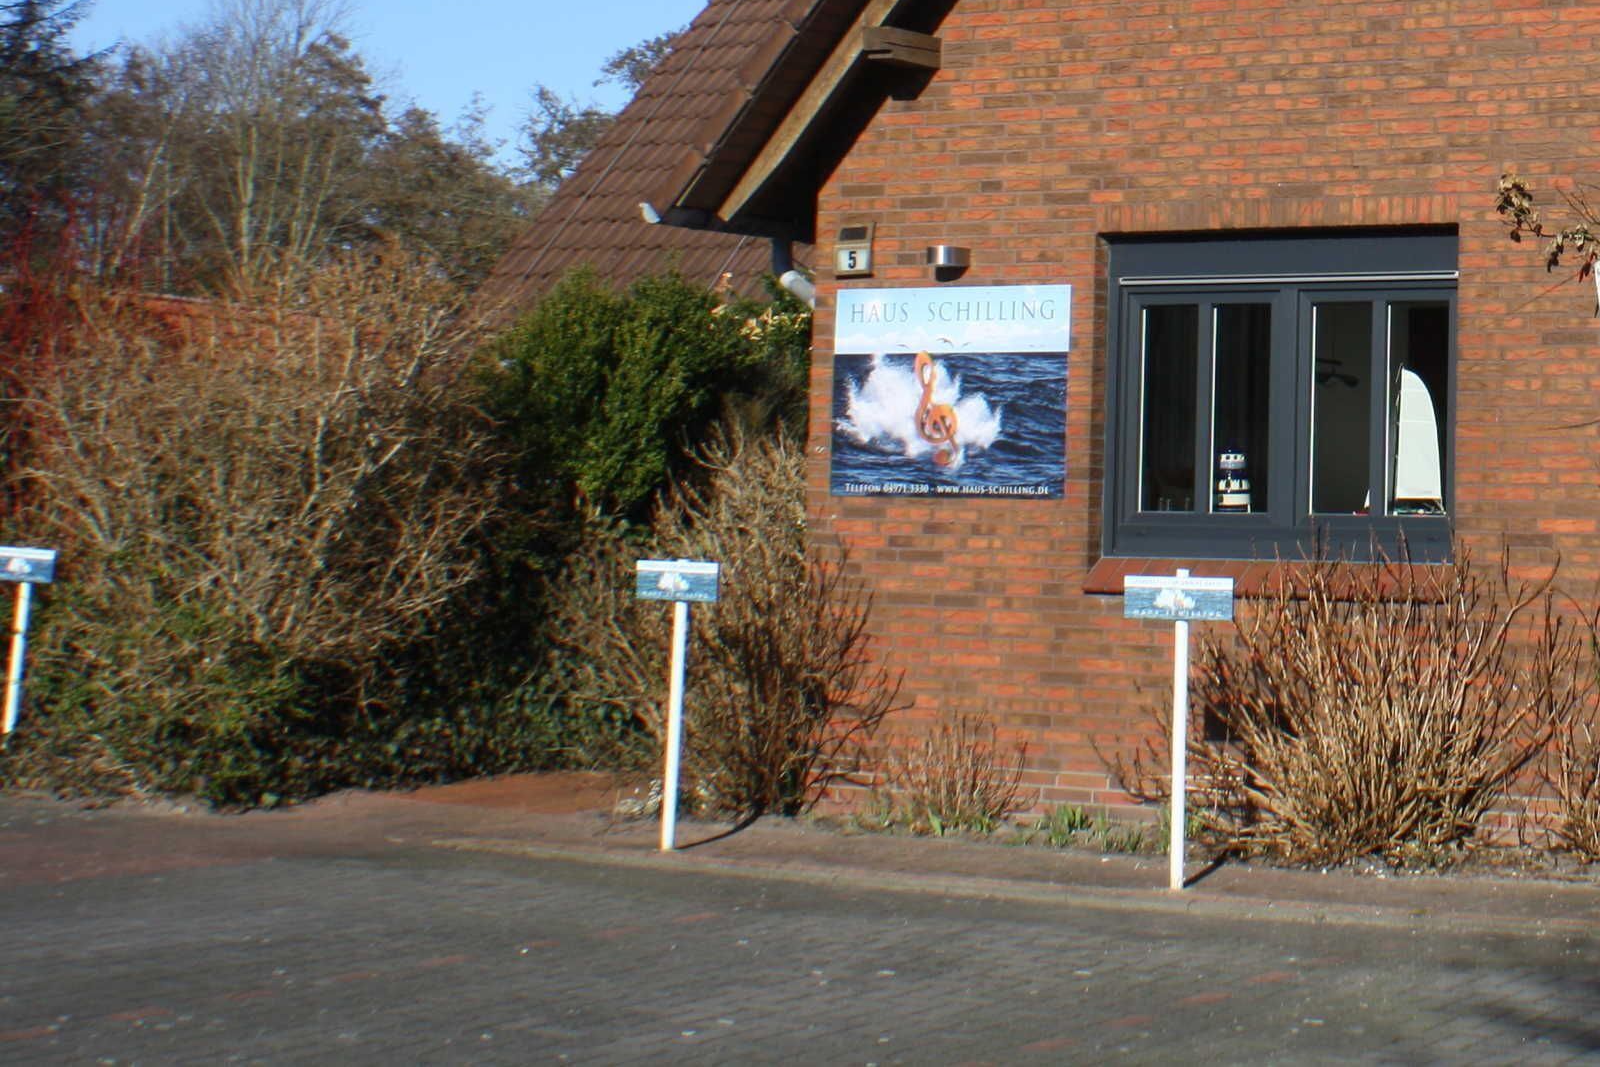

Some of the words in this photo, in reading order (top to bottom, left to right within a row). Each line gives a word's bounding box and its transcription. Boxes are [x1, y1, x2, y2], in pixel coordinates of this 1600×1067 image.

[847, 250, 857, 270] 5
[850, 302, 909, 324] HAUS
[927, 299, 1057, 322] SCHILLING
